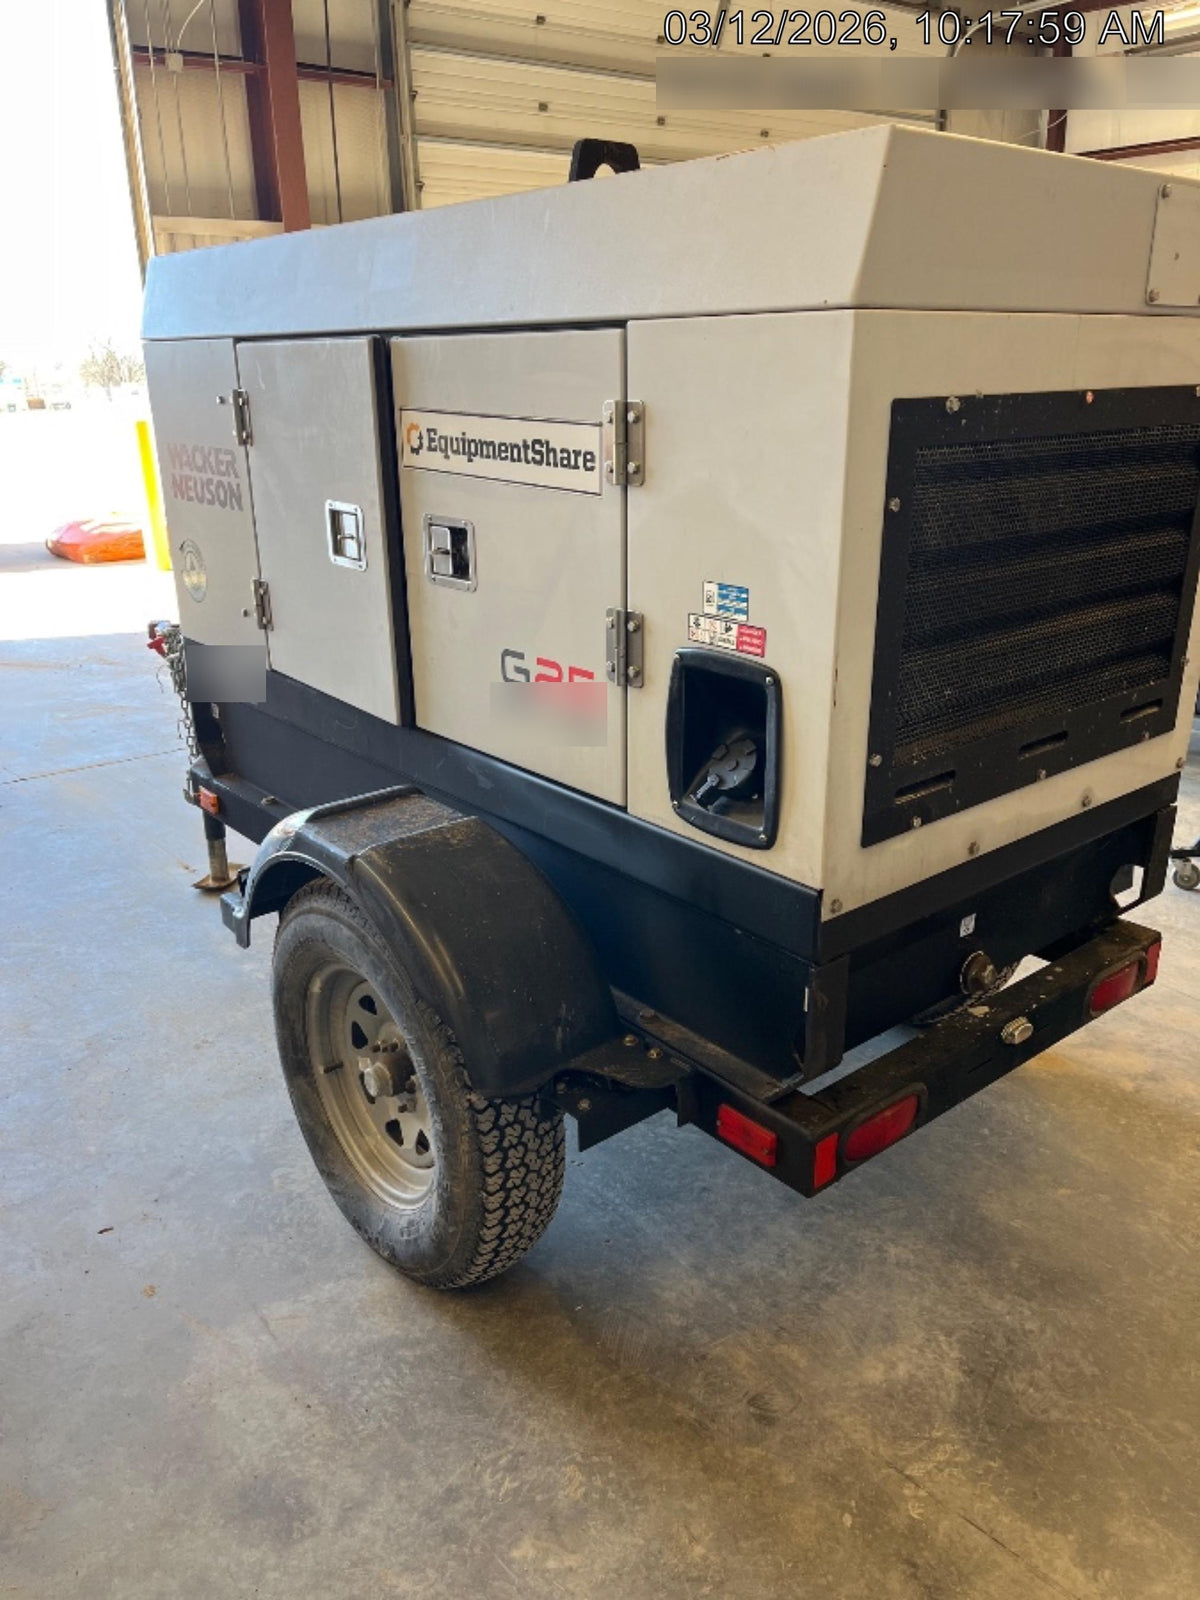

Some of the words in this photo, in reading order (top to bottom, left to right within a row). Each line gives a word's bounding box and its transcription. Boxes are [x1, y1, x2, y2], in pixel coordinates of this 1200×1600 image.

[167, 443, 240, 479] WACKER
[426, 428, 596, 472] EquipmentShare
[171, 472, 243, 512] NEUSON
